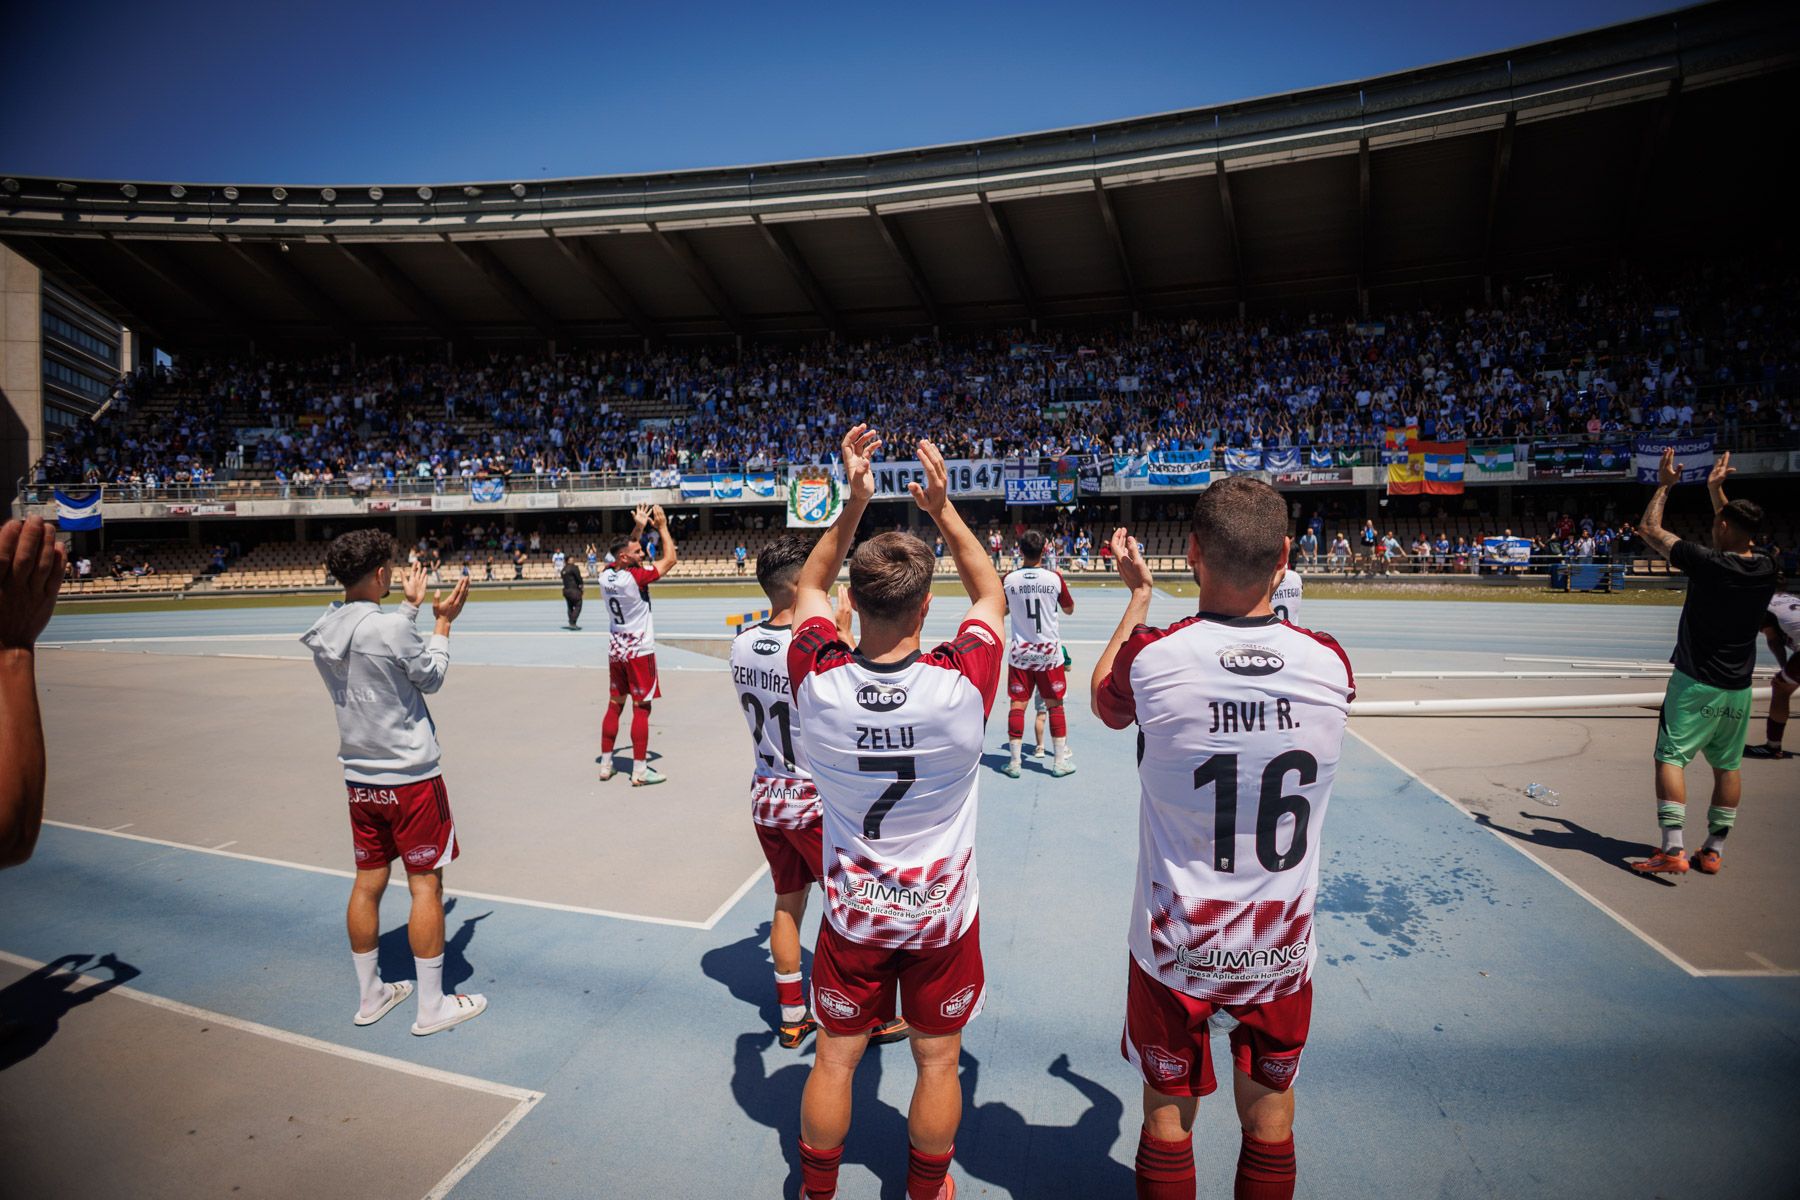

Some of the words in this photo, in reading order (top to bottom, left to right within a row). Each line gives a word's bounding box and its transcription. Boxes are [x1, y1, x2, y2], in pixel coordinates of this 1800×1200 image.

[950, 464, 1003, 491] 1947
[1007, 481, 1020, 491] EL
[1024, 480, 1057, 491] XIKLE
[1643, 469, 1706, 482] XEZ
[1007, 491, 1052, 501] FANS
[608, 597, 625, 625] 9
[1025, 599, 1042, 634] 4
[752, 639, 780, 653] LUGO
[1223, 655, 1283, 669] LUGO
[734, 665, 757, 688] ZEKI
[761, 669, 790, 695] DÍAZ
[858, 692, 907, 705] LUGO
[1208, 701, 1266, 734] JAVI
[1276, 697, 1301, 731] R.
[741, 692, 796, 773] 21
[856, 726, 915, 750] ZELU
[352, 788, 399, 805] JEALSA
[857, 756, 917, 840] 7
[1193, 749, 1318, 874] 16
[858, 882, 948, 907] JIMANG
[865, 905, 904, 918] Aplicadora
[905, 906, 951, 920] Homologada
[1201, 941, 1307, 968] JIMANG
[1174, 965, 1211, 979] Empresa
[1212, 971, 1259, 981] Aplicadora
